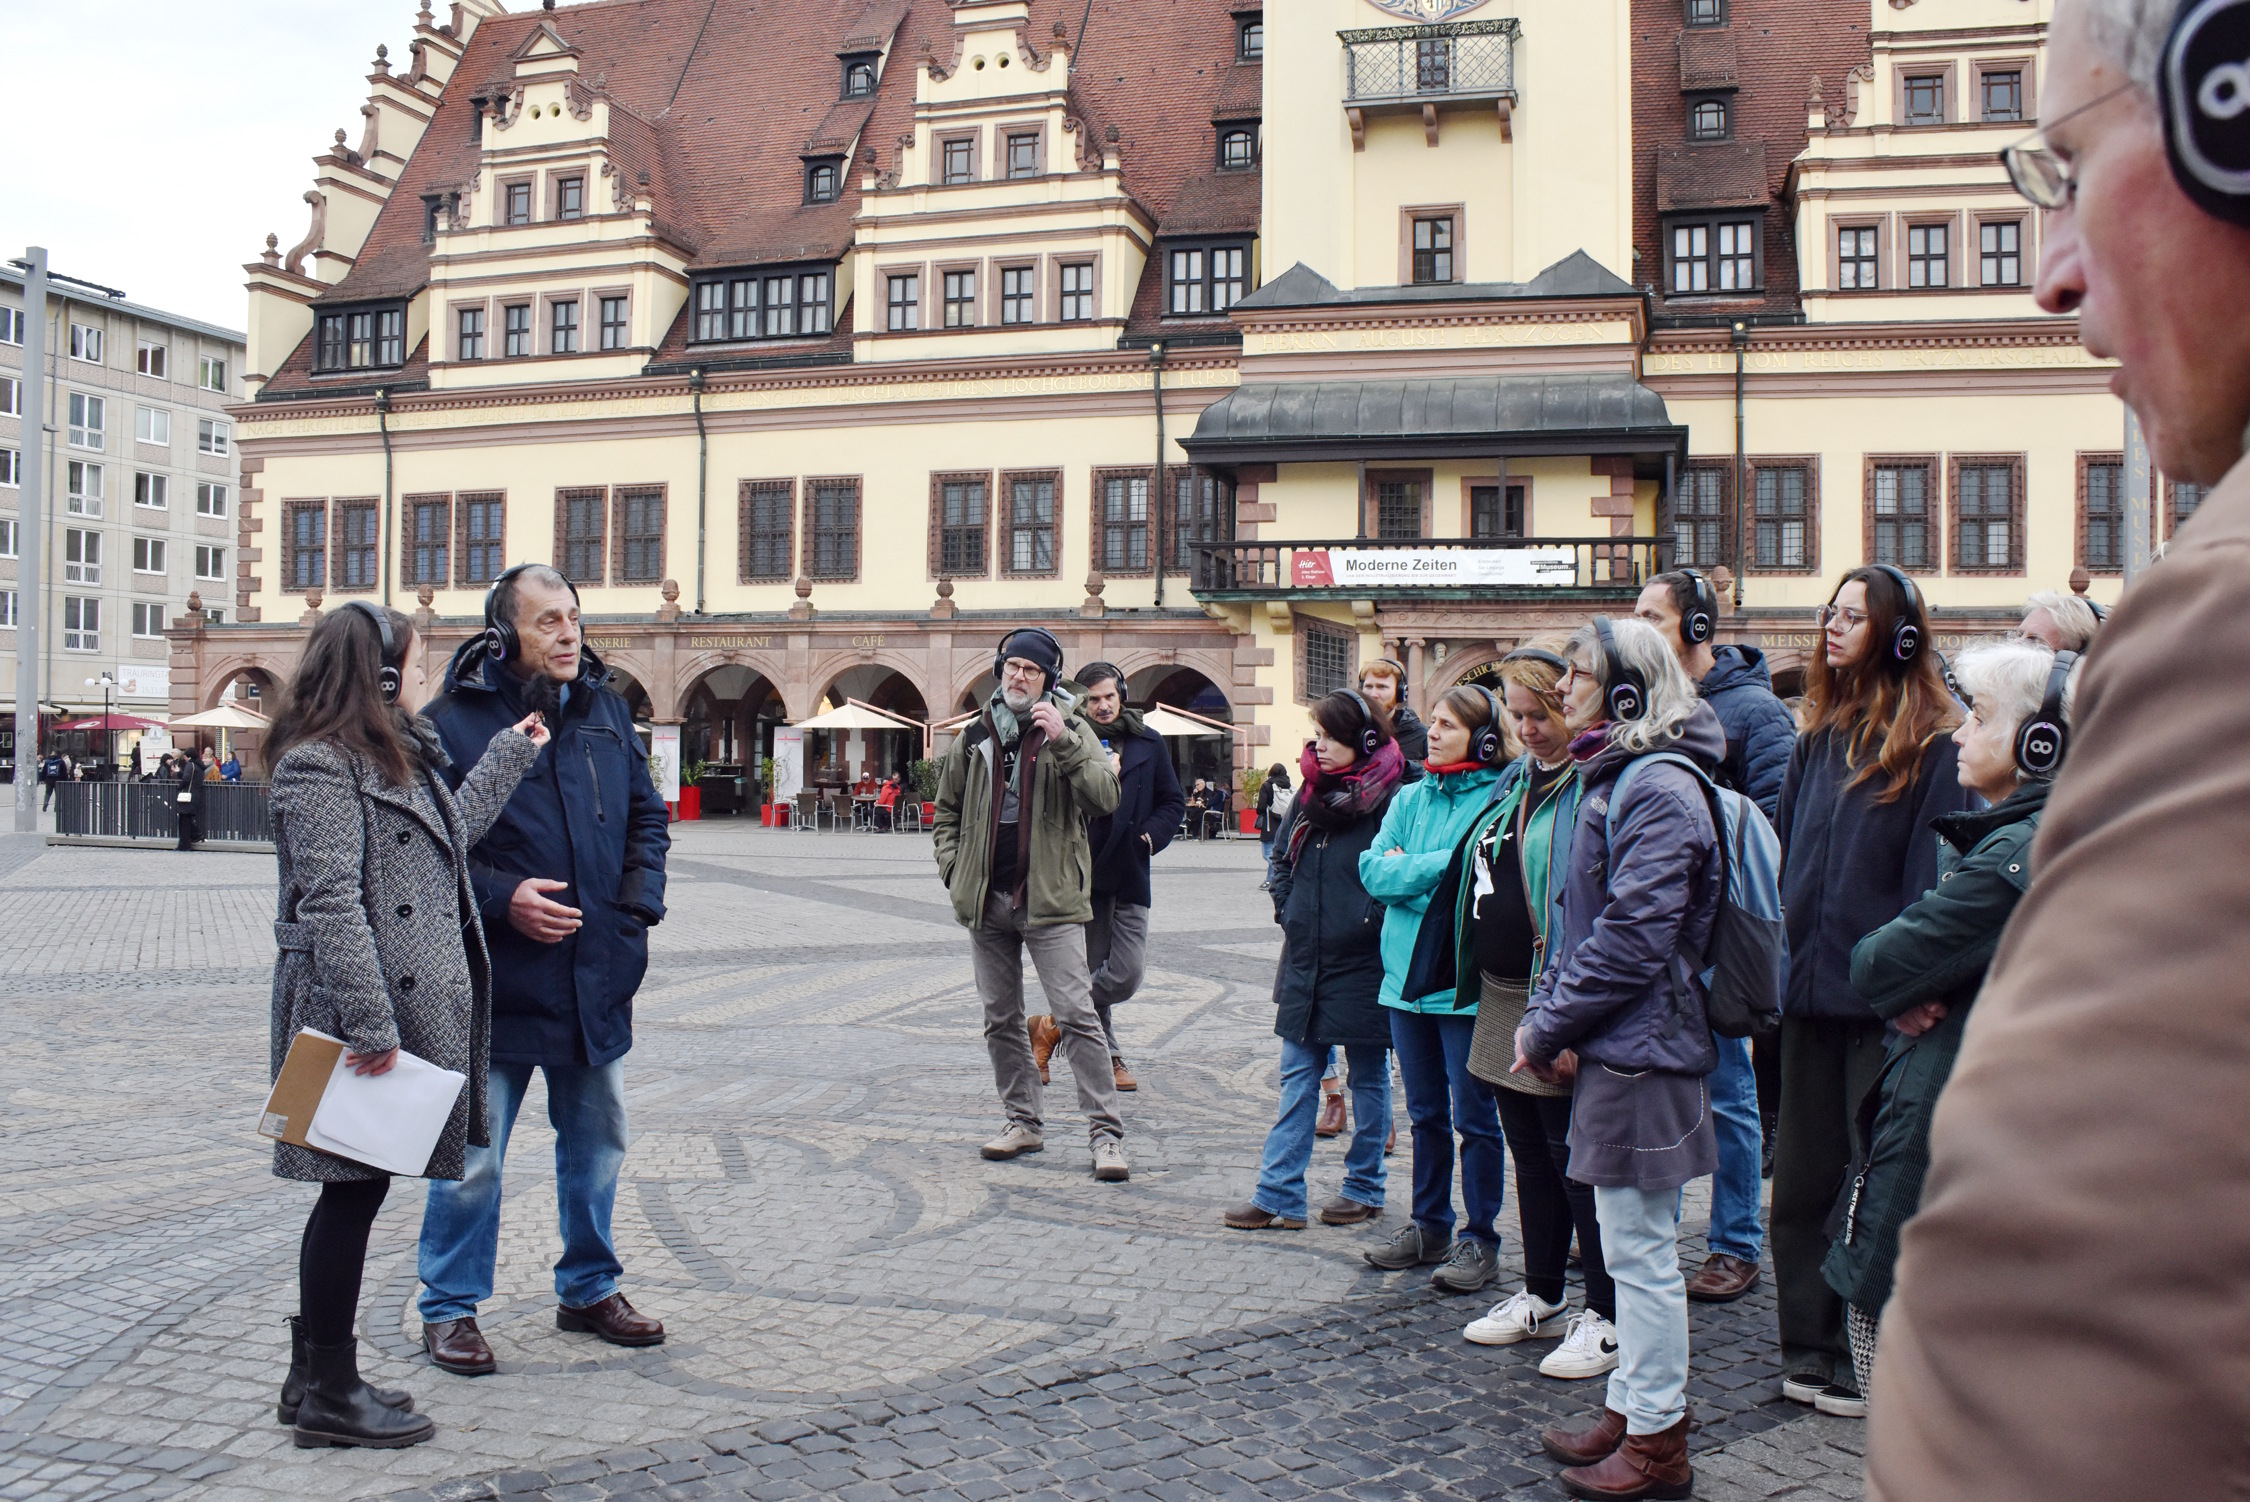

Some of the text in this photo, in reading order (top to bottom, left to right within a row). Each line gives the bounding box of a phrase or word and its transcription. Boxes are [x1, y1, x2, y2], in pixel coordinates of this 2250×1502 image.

[1262, 332, 1337, 351] HERRN
[1464, 323, 1606, 345] HERTZOGEN
[1652, 354, 1693, 371] DES
[1803, 351, 1884, 368] REICHS
[1901, 348, 2088, 367] ERTZMARSCHALL
[246, 422, 283, 436] NACH
[654, 397, 681, 411] BEY
[790, 389, 819, 404] DES
[827, 381, 994, 402] DURCHLAUCHTIGEN
[1298, 559, 1316, 569] Hier
[1346, 558, 1457, 571] Moderne Zeiten
[587, 637, 632, 648] ASSERIE
[691, 636, 773, 648] RESTAURANT
[852, 633, 886, 648] CAFÉ
[1761, 634, 1820, 647] MEISSE
